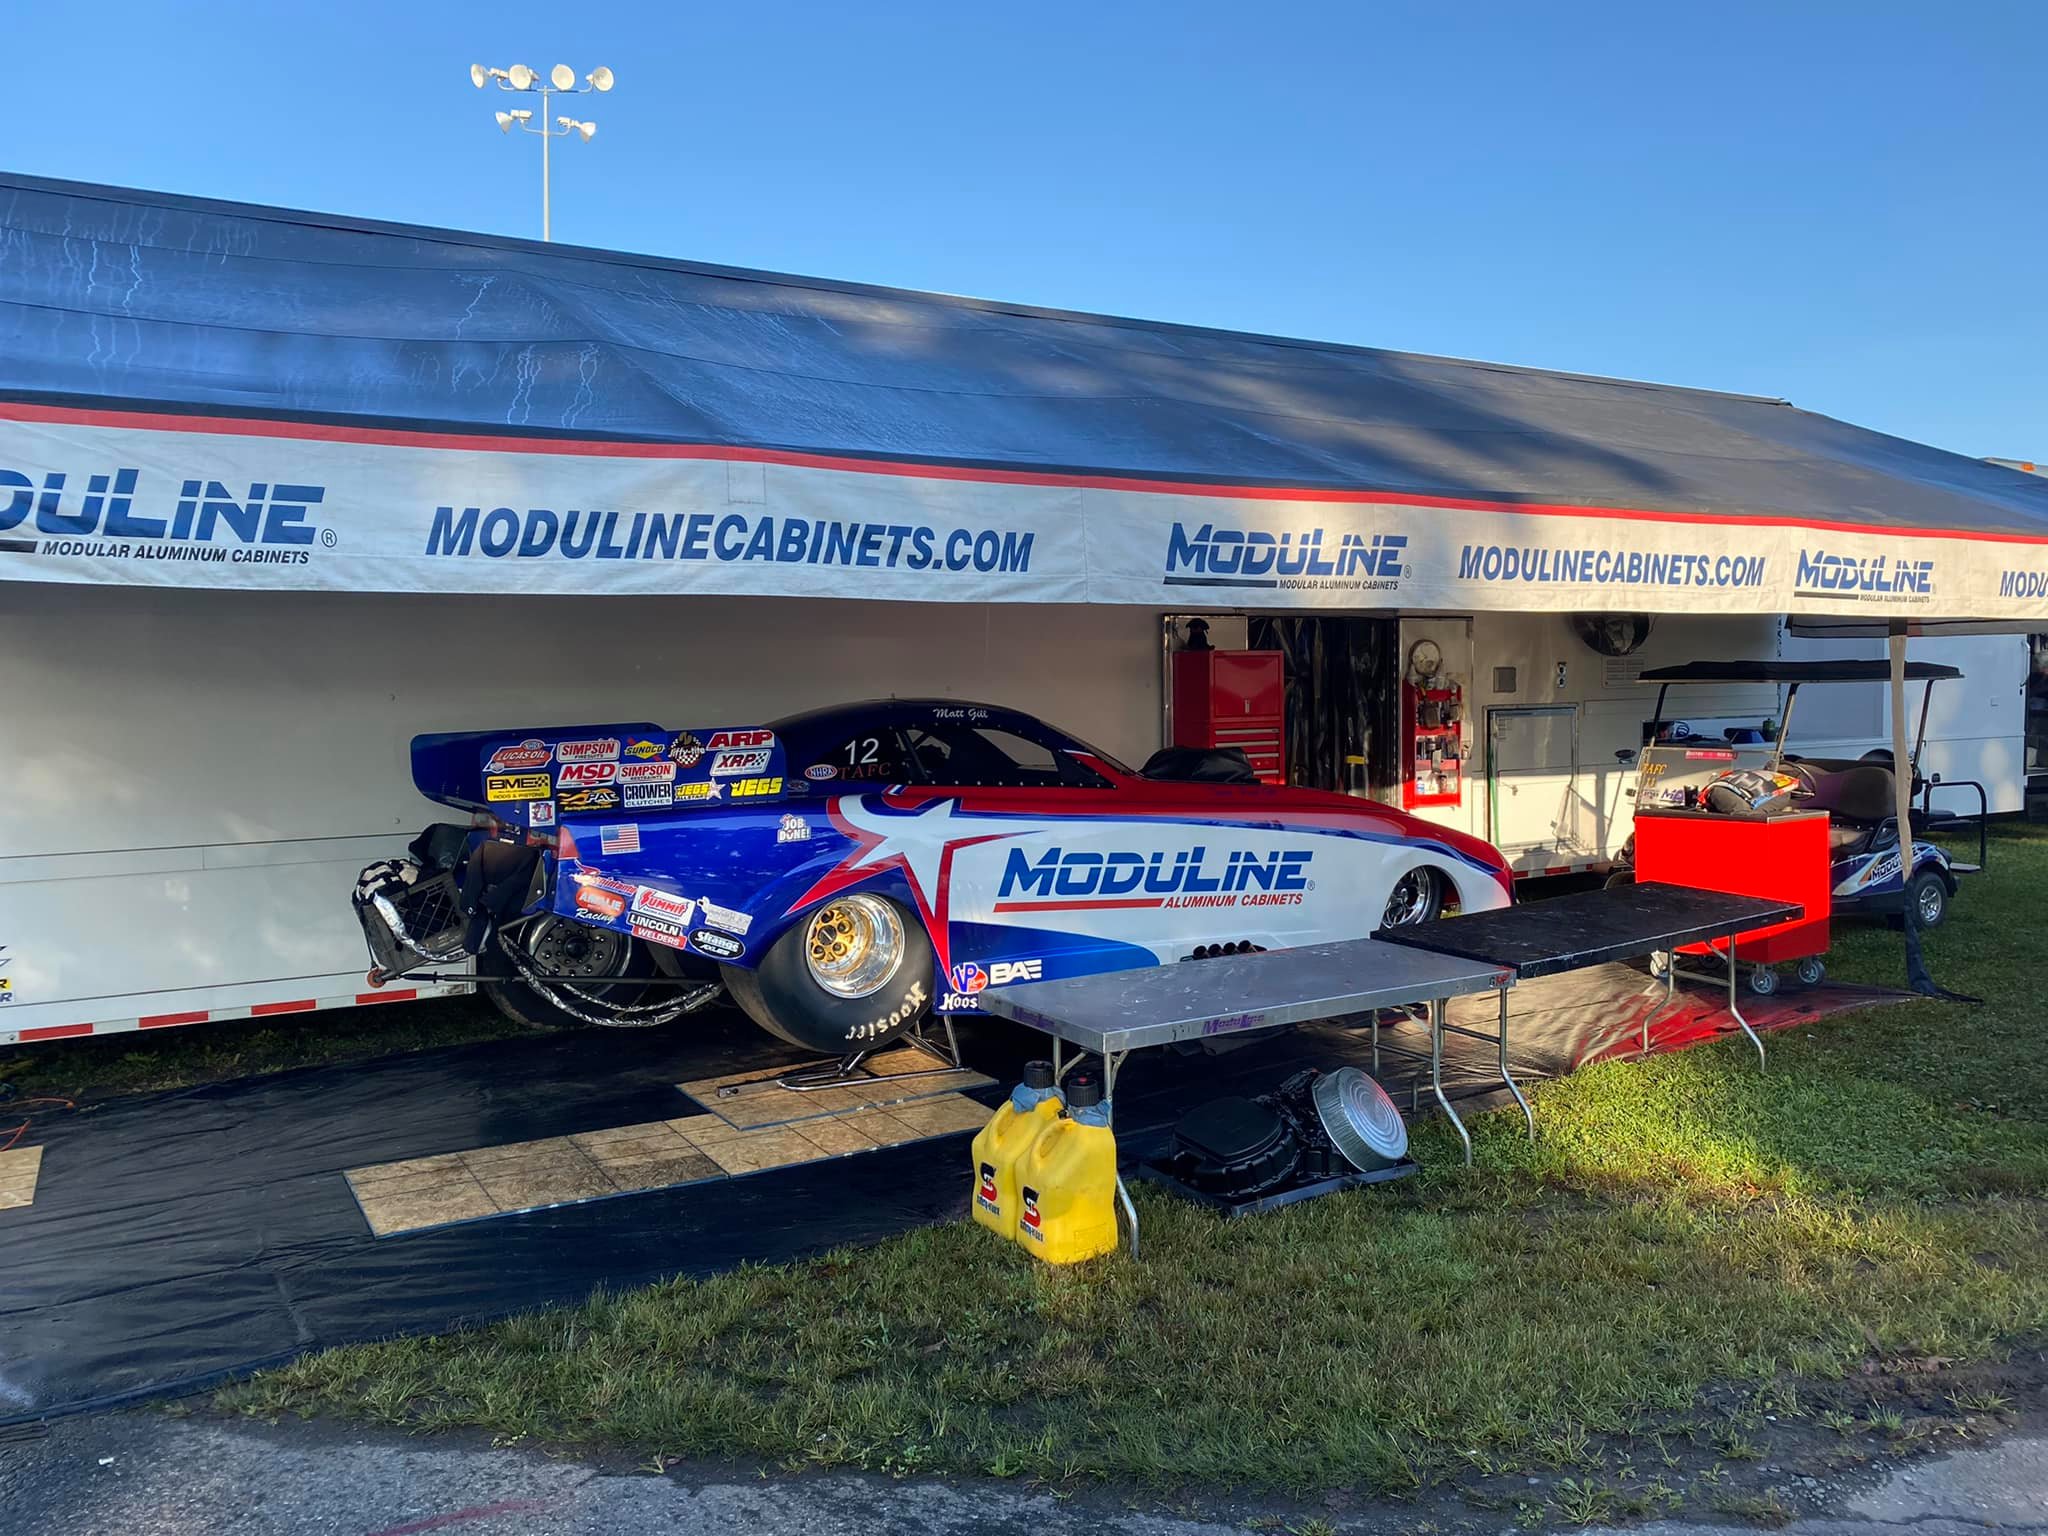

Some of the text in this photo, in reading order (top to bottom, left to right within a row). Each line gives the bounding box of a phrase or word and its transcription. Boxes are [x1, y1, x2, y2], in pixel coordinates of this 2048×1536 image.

[425, 506, 1035, 573] MODULINECABINETS.COM
[41, 540, 309, 564] MODULAR ALUMINUM CABINETS
[1166, 522, 1408, 577] MODULINE
[1458, 545, 1766, 586] MODULINECABINETS.COM
[1795, 549, 1934, 593] MODULINE
[1279, 579, 1399, 591] MODULAR ALUMINUM CABINETS
[933, 707, 988, 721] Matt Gill
[709, 730, 773, 748] ARP
[497, 751, 546, 761] LUCAS OIL
[562, 743, 615, 756] SIMPSON
[626, 745, 664, 755] SUNOCO
[845, 738, 879, 765] 12
[718, 754, 756, 768] XRP
[561, 763, 616, 780] MSD
[621, 765, 671, 777] SIMPSON
[810, 766, 834, 778] NHRA
[489, 777, 536, 790] BME
[625, 783, 671, 800] CROWER
[677, 783, 709, 796] JEGS
[731, 777, 783, 797] JEGS
[625, 799, 671, 807] CLUTCHES
[784, 817, 804, 831] JOB
[779, 828, 810, 842] DONE!
[997, 846, 1314, 898] MODULINE
[1164, 893, 1303, 909] ALUMINUM CABINETS
[575, 907, 617, 925] Racing
[630, 913, 680, 936] LINCOLN
[638, 928, 680, 946] WELDERS
[952, 962, 978, 993] VP
[989, 959, 1042, 985] BAE
[938, 992, 978, 1011] Hoos
[845, 980, 928, 1042] Hoosier
